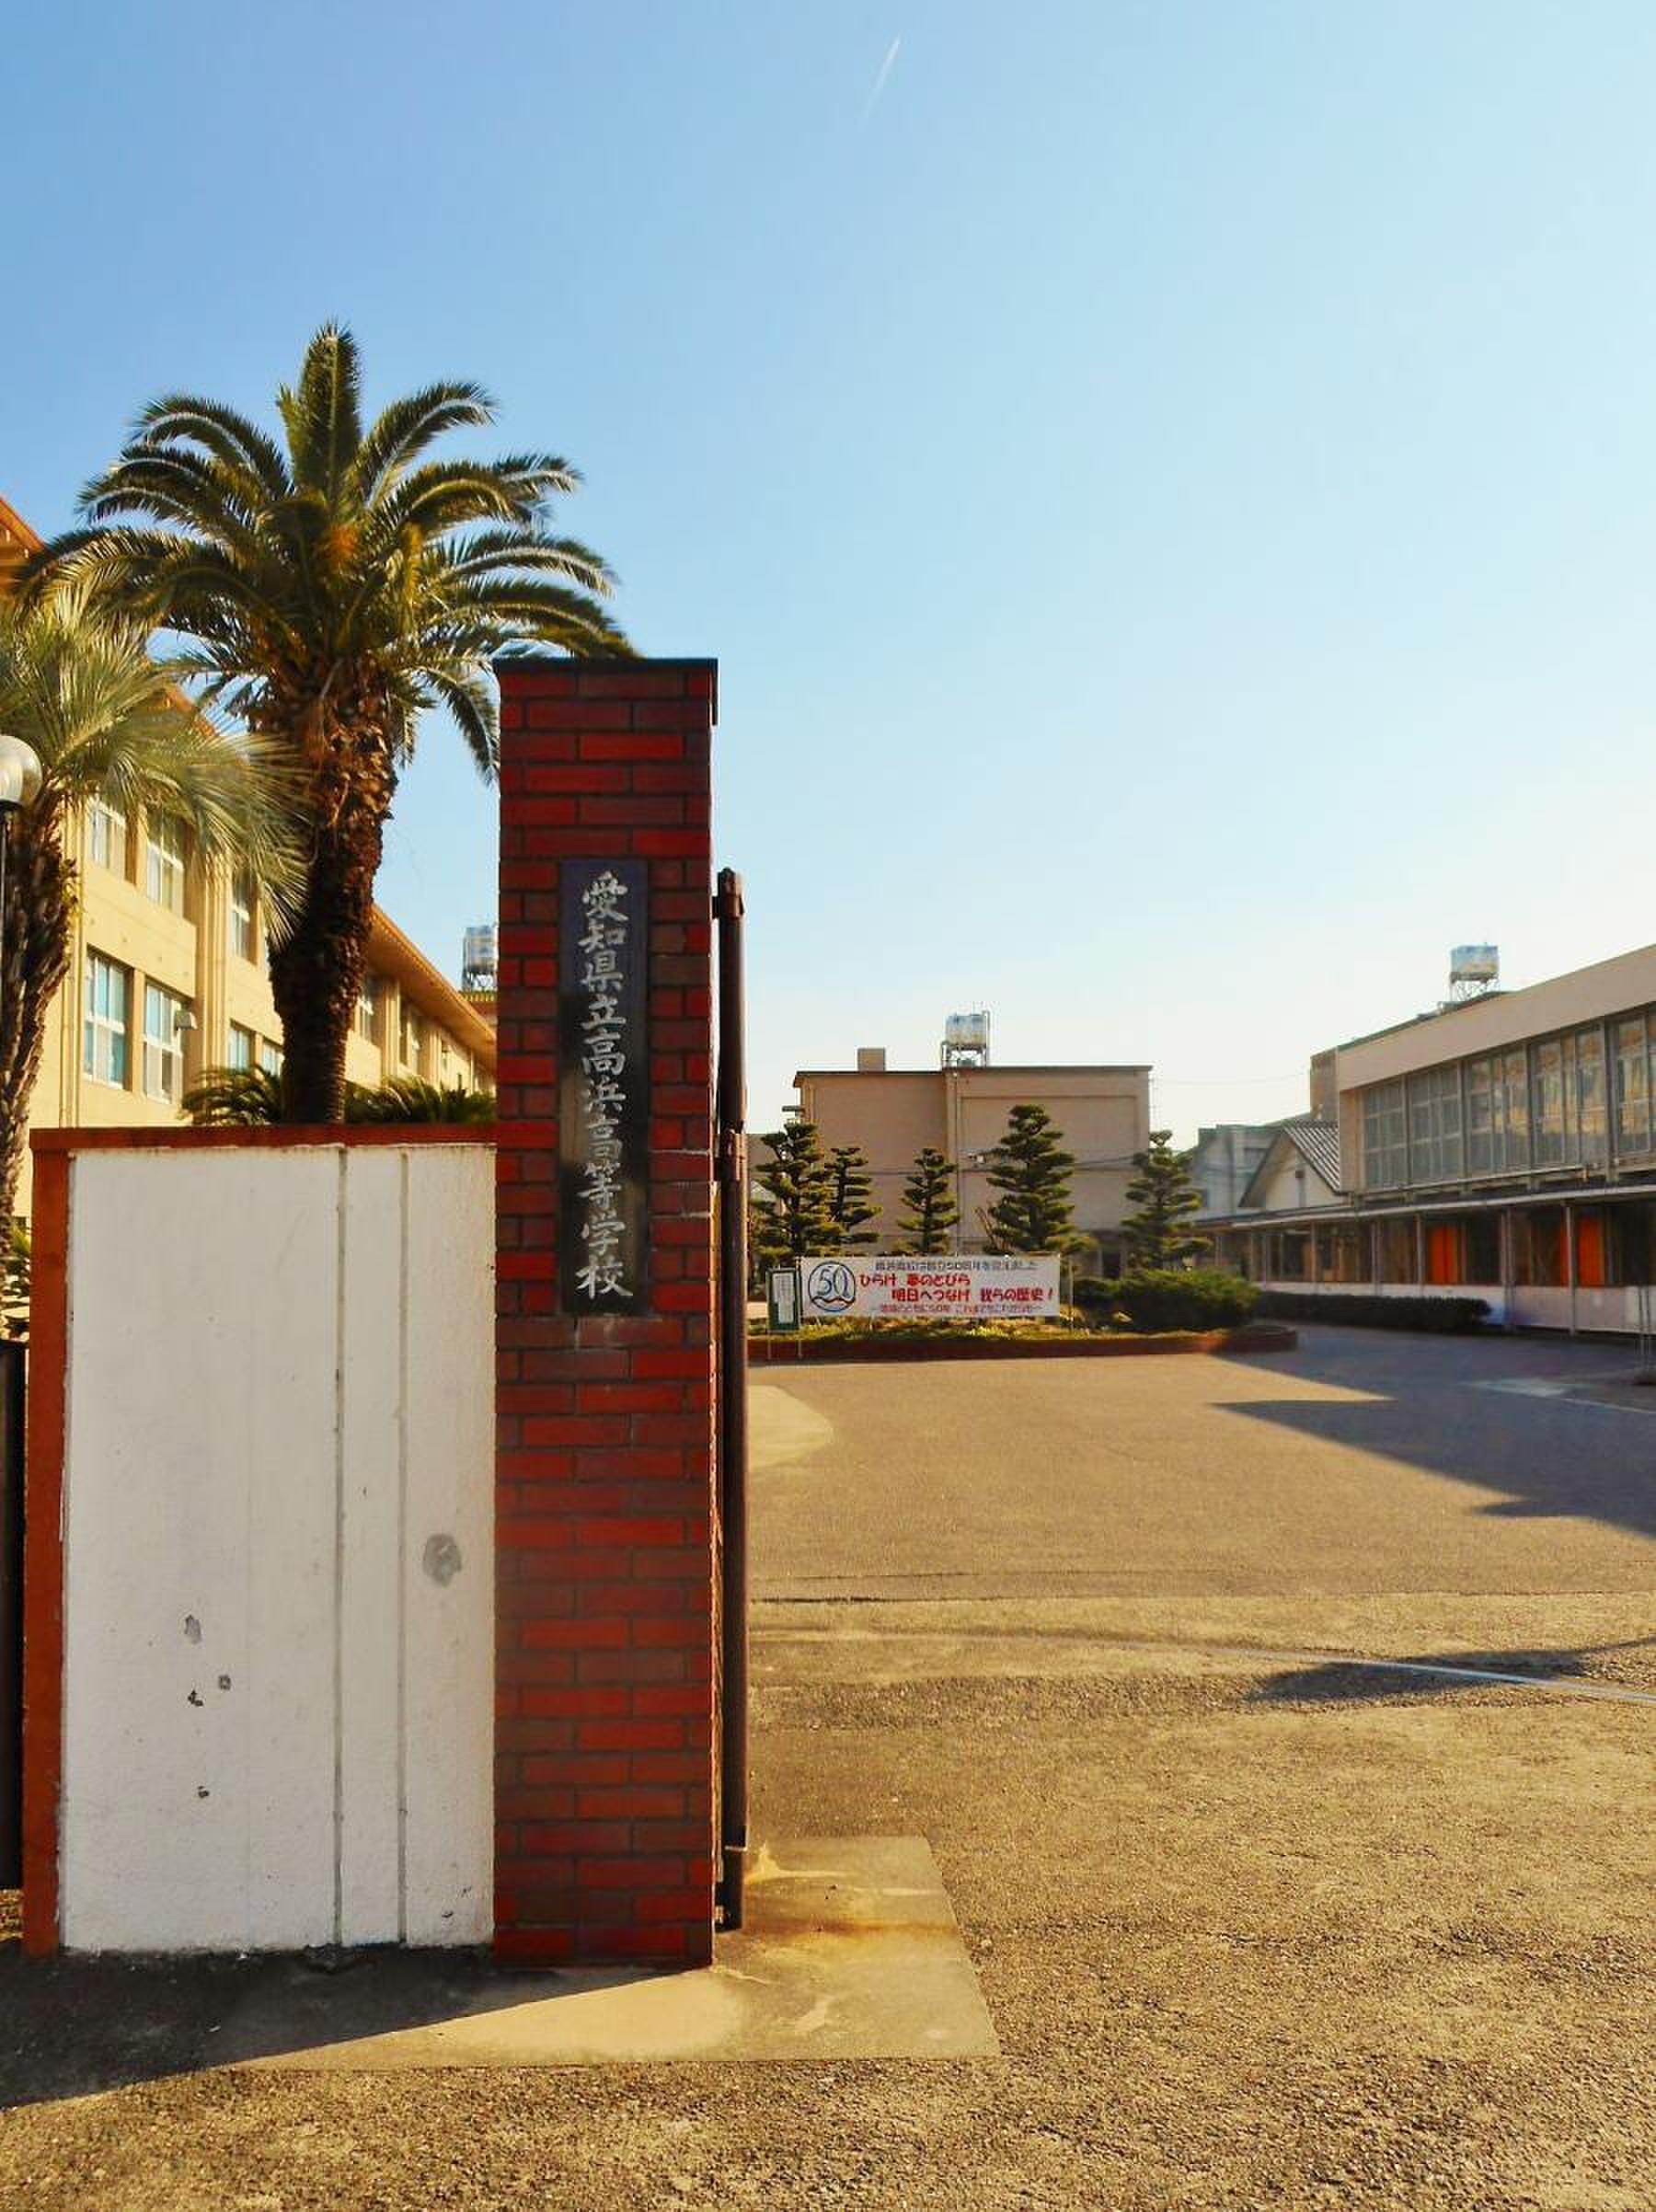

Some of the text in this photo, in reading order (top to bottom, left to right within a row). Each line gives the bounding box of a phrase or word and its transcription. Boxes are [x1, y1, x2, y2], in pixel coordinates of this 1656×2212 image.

[576, 870, 633, 1299] 愛知県立高浜高等学校
[817, 1265, 849, 1296] 50
[859, 1273, 897, 1286] ひらけ
[891, 1288, 970, 1303] 明日へつなげ
